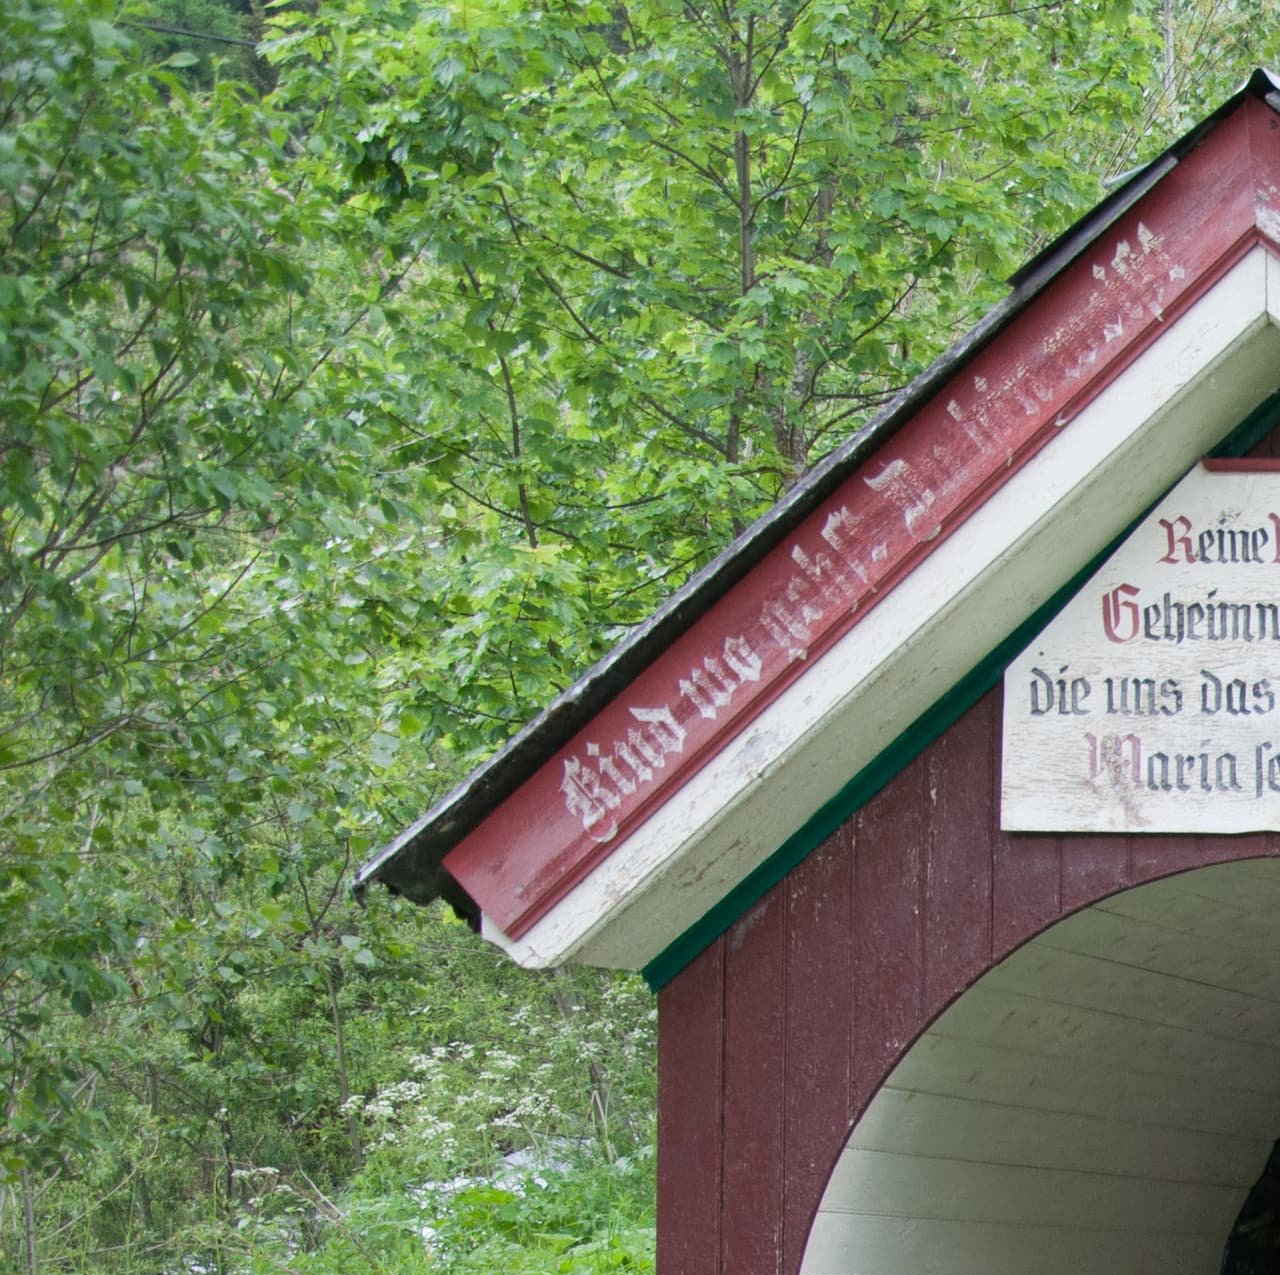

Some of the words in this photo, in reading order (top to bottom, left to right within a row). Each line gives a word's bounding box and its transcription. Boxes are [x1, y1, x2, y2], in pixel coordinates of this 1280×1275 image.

[1158, 515, 1269, 566] Reine
[1030, 666, 1091, 717] die
[1105, 672, 1183, 717] uns
[1200, 669, 1275, 717] das
[560, 705, 681, 841] Kind
[677, 637, 761, 718] wo
[1085, 733, 1242, 794] Maria
